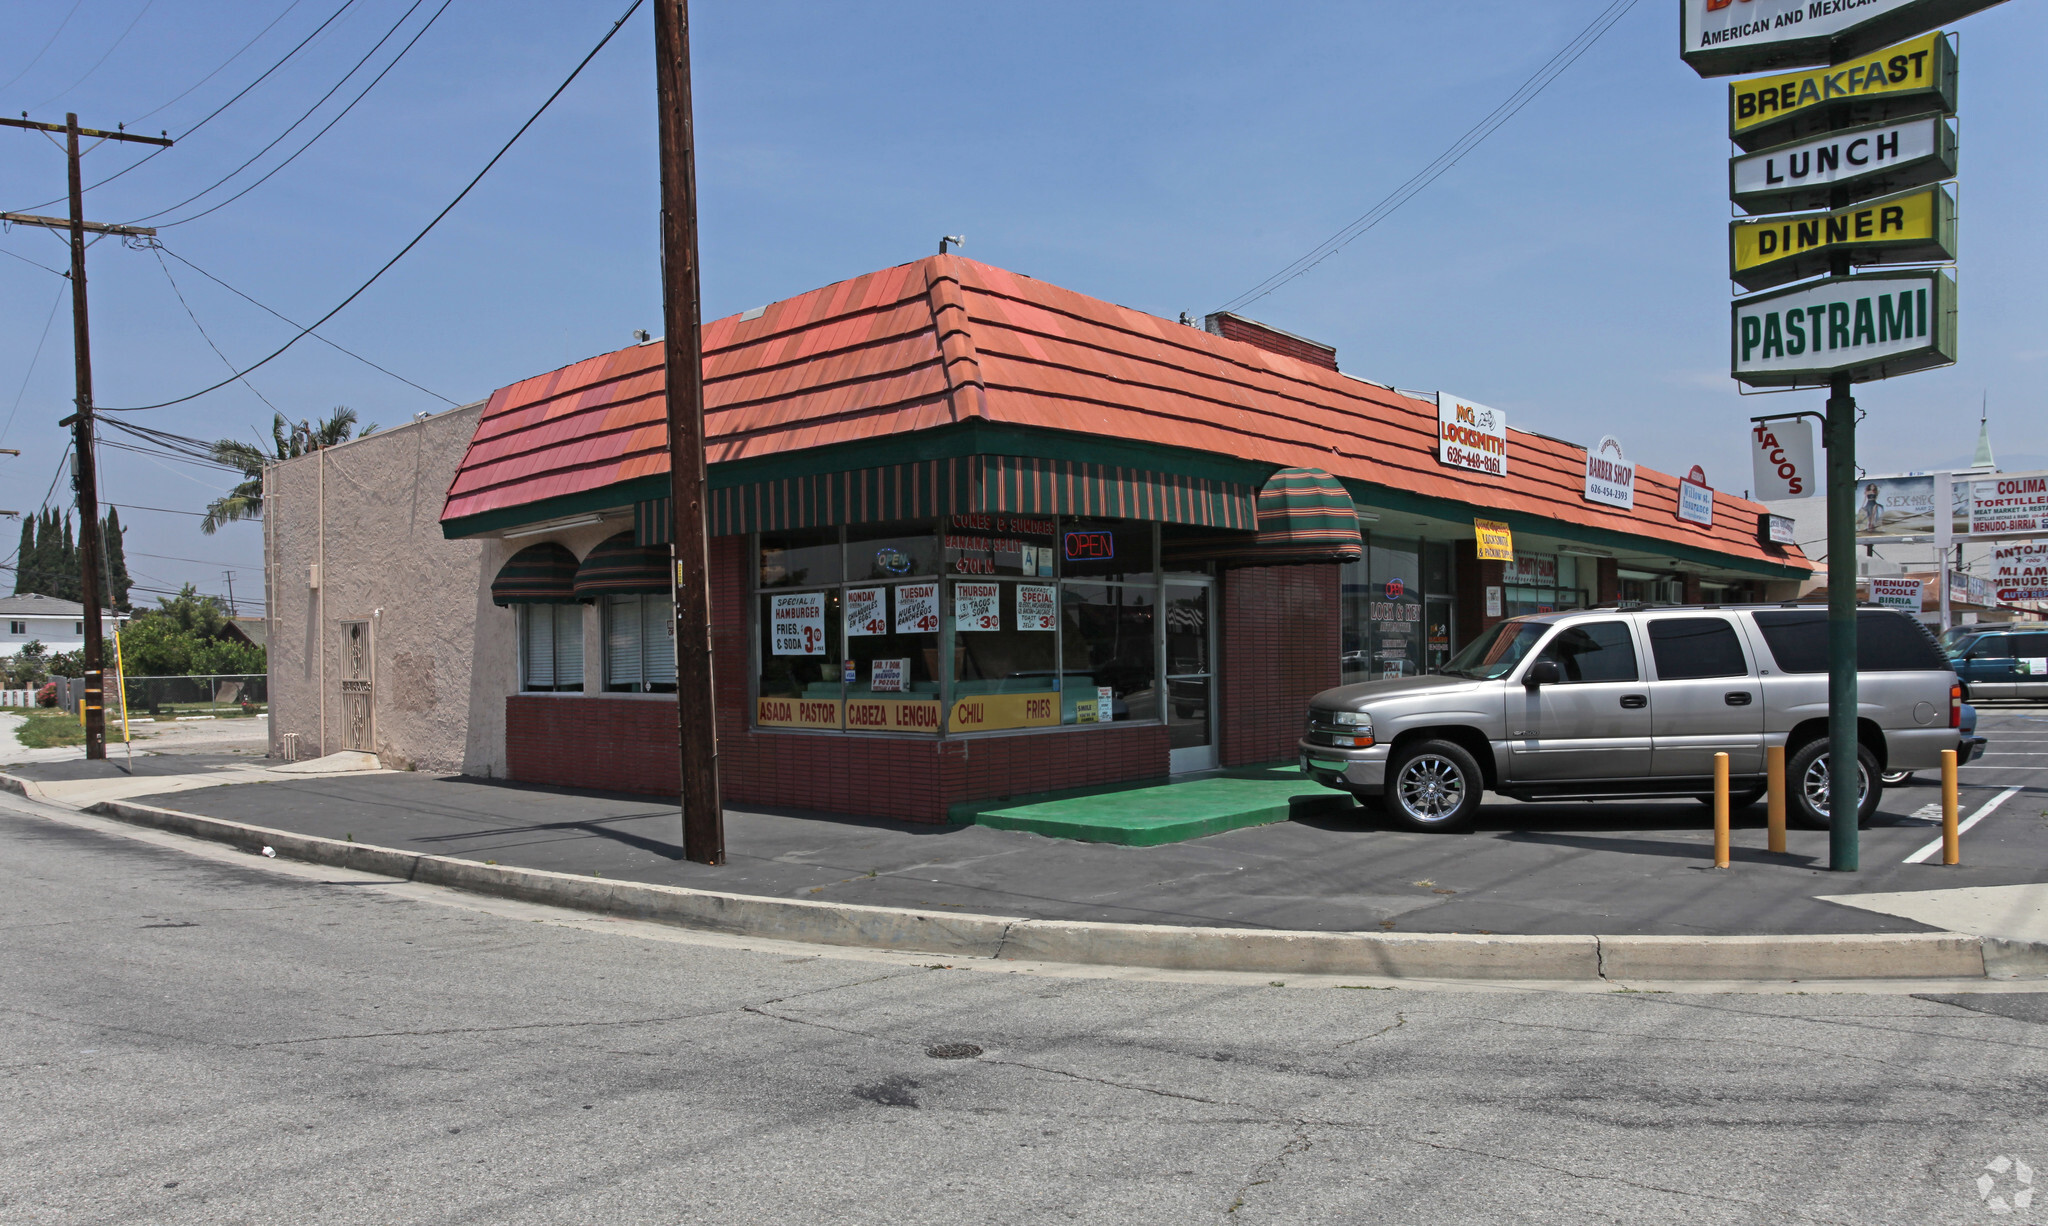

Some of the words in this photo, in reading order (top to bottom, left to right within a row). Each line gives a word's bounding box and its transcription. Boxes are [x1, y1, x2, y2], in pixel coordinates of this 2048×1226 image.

[1701, 19, 1770, 47] AMERICAN
[1775, 9, 1803, 29] AND
[1738, 50, 1928, 119] BREAKFAST
[1766, 131, 1898, 184] LUNCH
[1758, 206, 1904, 255] DINNER
[1741, 288, 1927, 361] PASTRAMI
[1456, 403, 1475, 427] MG
[1441, 421, 1504, 456] LOCKSMITH
[1447, 446, 1500, 473] 626-448-8161
[1753, 426, 1802, 494] TACOS
[1589, 456, 1613, 482] BARBER
[1614, 464, 1632, 487] SHOP
[1590, 483, 1628, 500] 626-454-2393
[1684, 484, 1702, 500] Willow
[1997, 479, 2047, 495] COLIMA
[1682, 496, 1709, 514] Insurance
[1886, 495, 1910, 507] SEX
[1975, 495, 2048, 508] TORTILLE
[952, 513, 992, 530] CONES
[997, 516, 1008, 532] &
[1011, 518, 1055, 535] SUNDAES
[1973, 519, 2037, 532] MENUDO-BIRRIA
[945, 534, 990, 551] BANANA
[993, 537, 1022, 553] SPLIT
[1066, 533, 1112, 557] OPEN
[878, 553, 908, 568] OPEN
[1025, 551, 1032, 566] A
[1996, 545, 2048, 560] ANTOJI
[956, 557, 982, 575] 4701
[1518, 556, 1537, 575] BEAUTY
[1999, 566, 2017, 576] MI
[957, 586, 997, 597] THURSDAY
[1385, 583, 1404, 596] OPEN
[1873, 579, 1920, 588] MENUDO
[1875, 587, 1917, 596] POZOLE
[848, 590, 876, 602] MONDAY
[900, 586, 934, 599] TUESDAY
[1022, 592, 1053, 603] SPECIAL
[1878, 596, 1912, 605] BIRRIA
[2003, 591, 2029, 599] AUTO
[777, 598, 808, 607] SPECIAL
[898, 599, 925, 618] HUEVOS
[969, 598, 991, 609] TACOS
[775, 606, 820, 620] HAMBURGER
[897, 605, 932, 626] RANCHEROS
[972, 606, 990, 617] SODA
[1370, 601, 1395, 621] LOCK
[1396, 603, 1404, 621] &
[1405, 603, 1421, 622] KEY
[776, 638, 782, 650] &
[783, 638, 802, 650] SODA
[760, 701, 792, 721] ASADA
[800, 702, 835, 723] PASTOR
[848, 703, 887, 725] CABEZA
[896, 704, 938, 727] LENGUA
[958, 703, 984, 724] CHILI
[1026, 698, 1051, 719] FRIES
